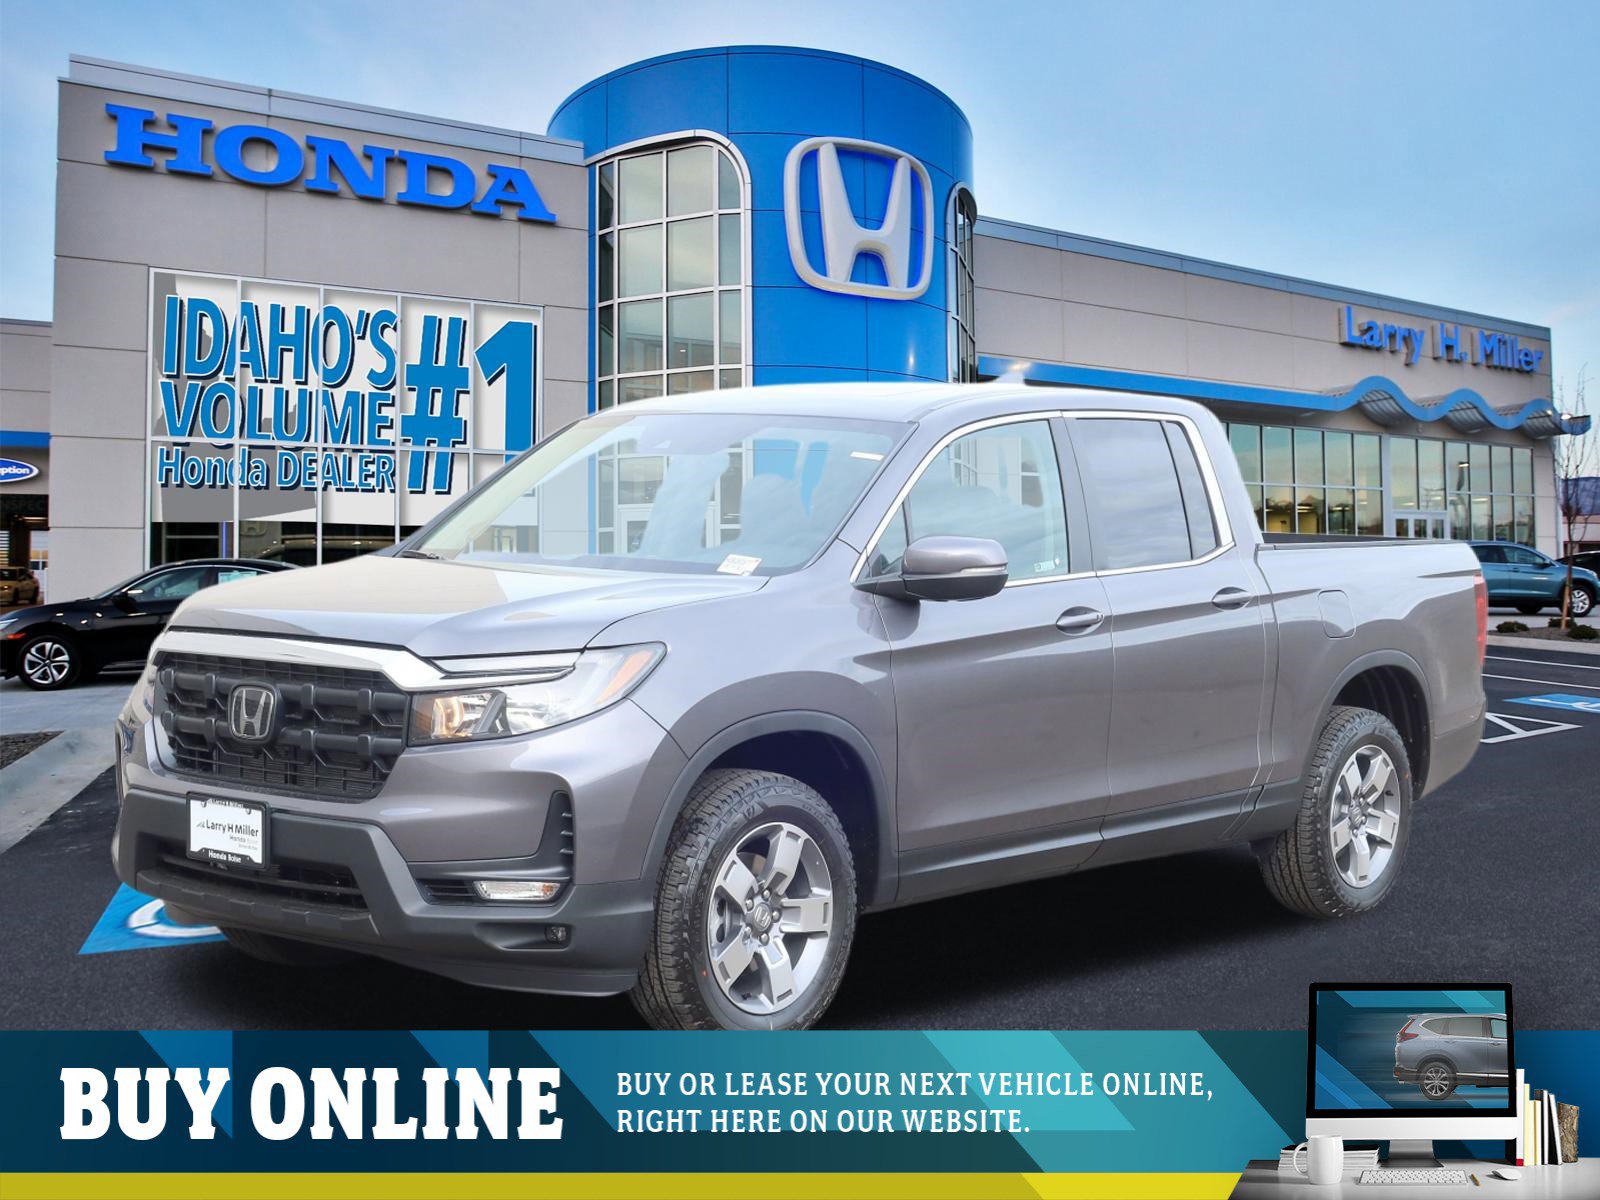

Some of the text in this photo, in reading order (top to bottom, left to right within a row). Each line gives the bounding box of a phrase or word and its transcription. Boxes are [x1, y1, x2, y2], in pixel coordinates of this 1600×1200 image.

[104, 103, 557, 223] HONDA
[162, 294, 398, 390] IDAHO'S
[1343, 305, 1544, 372] Larry H. Miller
[159, 380, 398, 452] VOLUME
[400, 315, 537, 494] #1
[0, 466, 30, 475] ption
[157, 446, 396, 492] Honda DEALER
[206, 819, 259, 838] Larry H Miller
[208, 850, 226, 861] Honda
